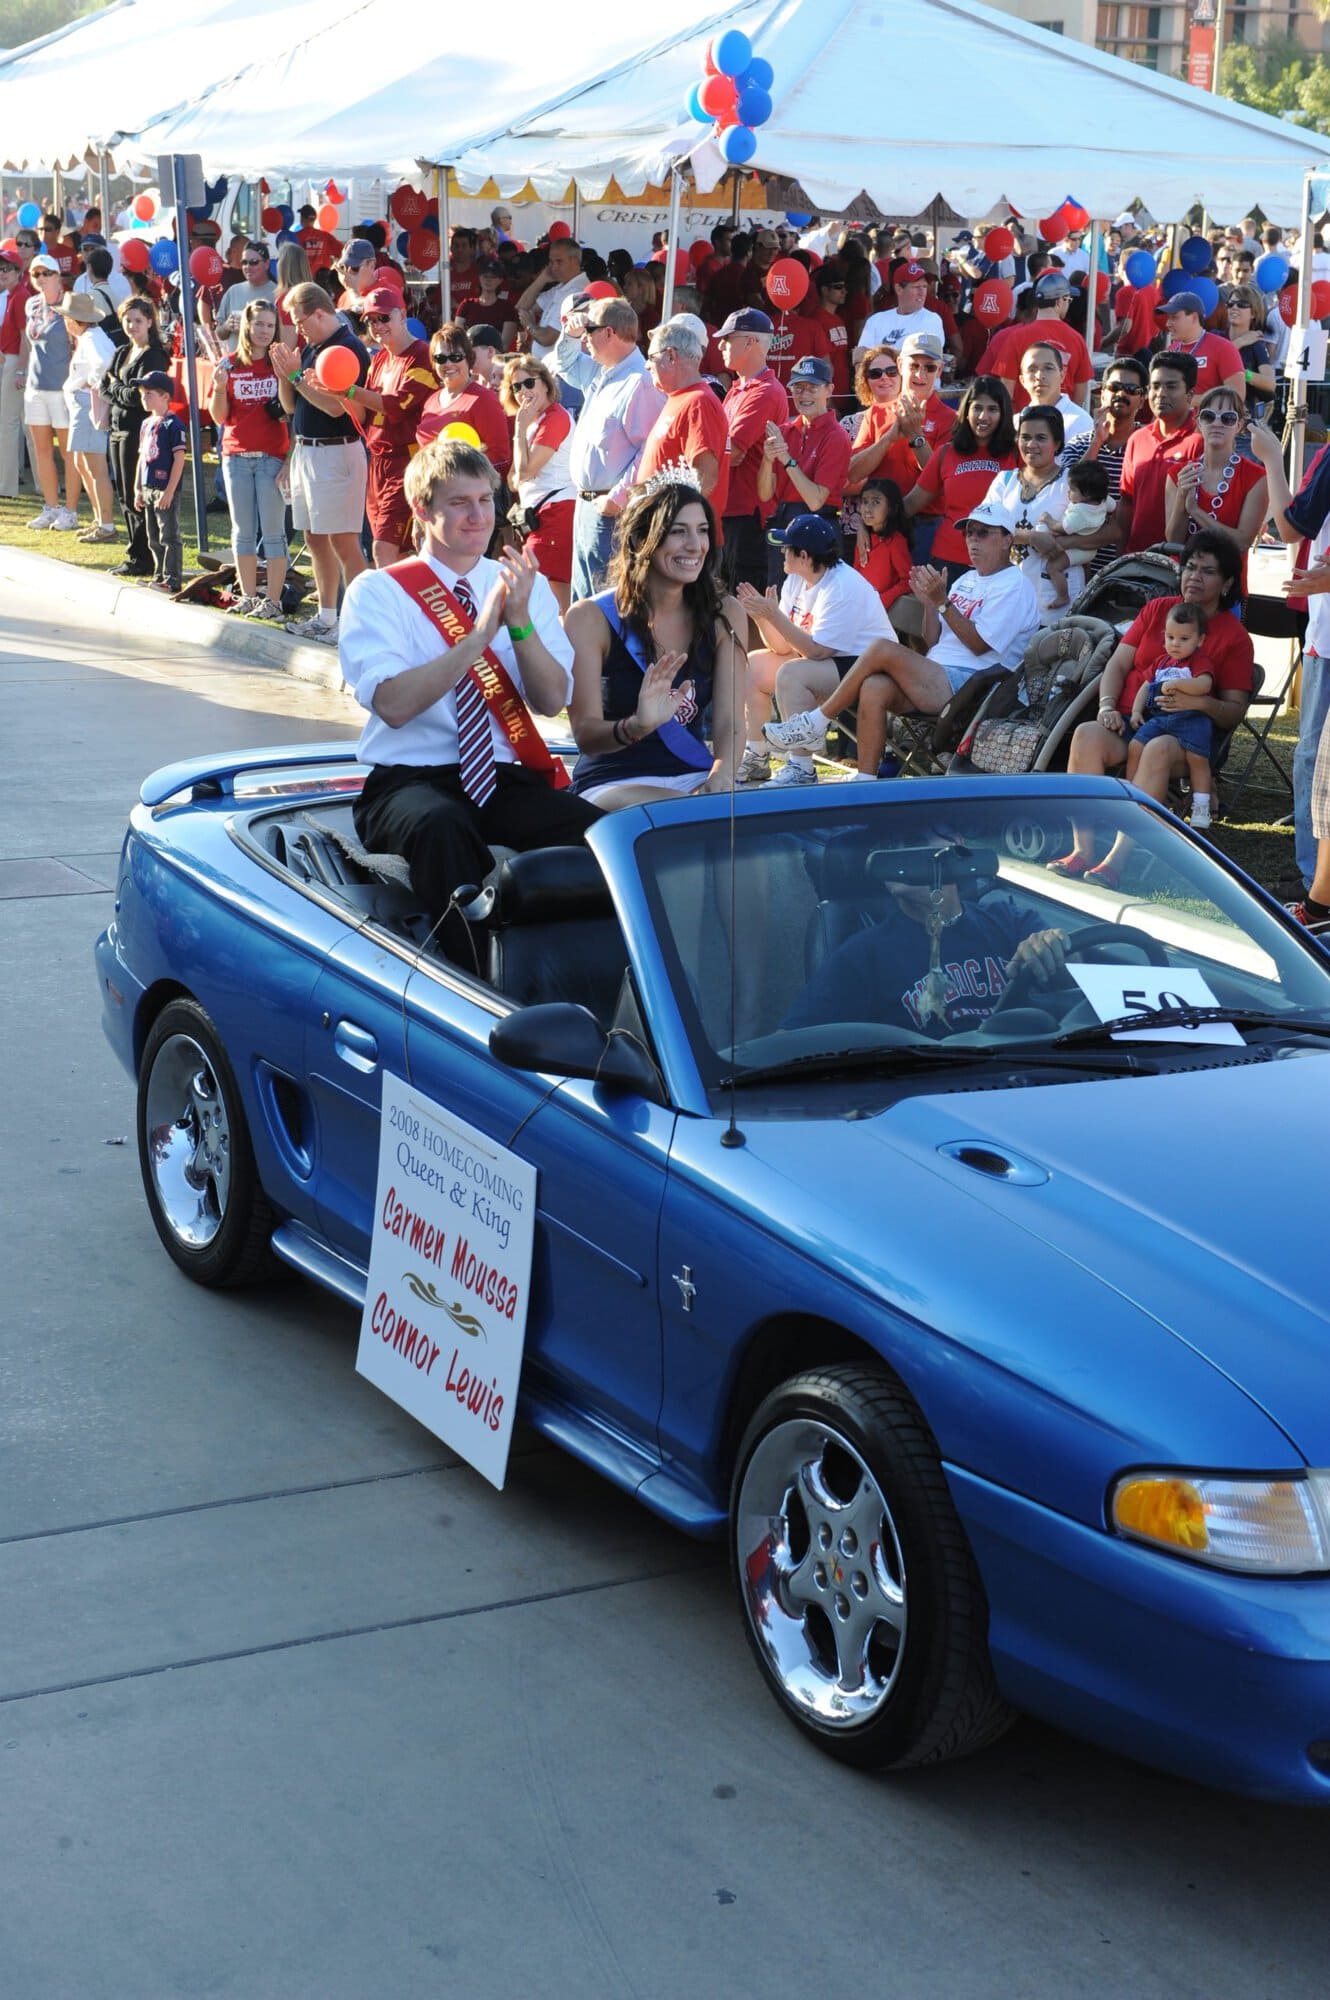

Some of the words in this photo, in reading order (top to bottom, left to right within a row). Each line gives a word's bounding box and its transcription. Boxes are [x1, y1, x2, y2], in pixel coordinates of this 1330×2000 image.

[597, 208, 668, 225] CRISP
[686, 210, 762, 227] CLEN
[772, 275, 790, 296] A
[980, 293, 999, 313] A
[1296, 346, 1311, 371] 4
[954, 459, 1001, 476] ARIZONA
[501, 698, 528, 744] King
[1122, 990, 1200, 1030] 50
[389, 1105, 420, 1141] 2008
[423, 1126, 523, 1212] HOMECOMING
[397, 1142, 445, 1194] Queen
[450, 1181, 467, 1208] &
[472, 1192, 511, 1250] King
[383, 1186, 445, 1269] Carmen
[451, 1234, 518, 1321] Moussa
[371, 1291, 440, 1376] Connor
[445, 1348, 504, 1431] Lewis
